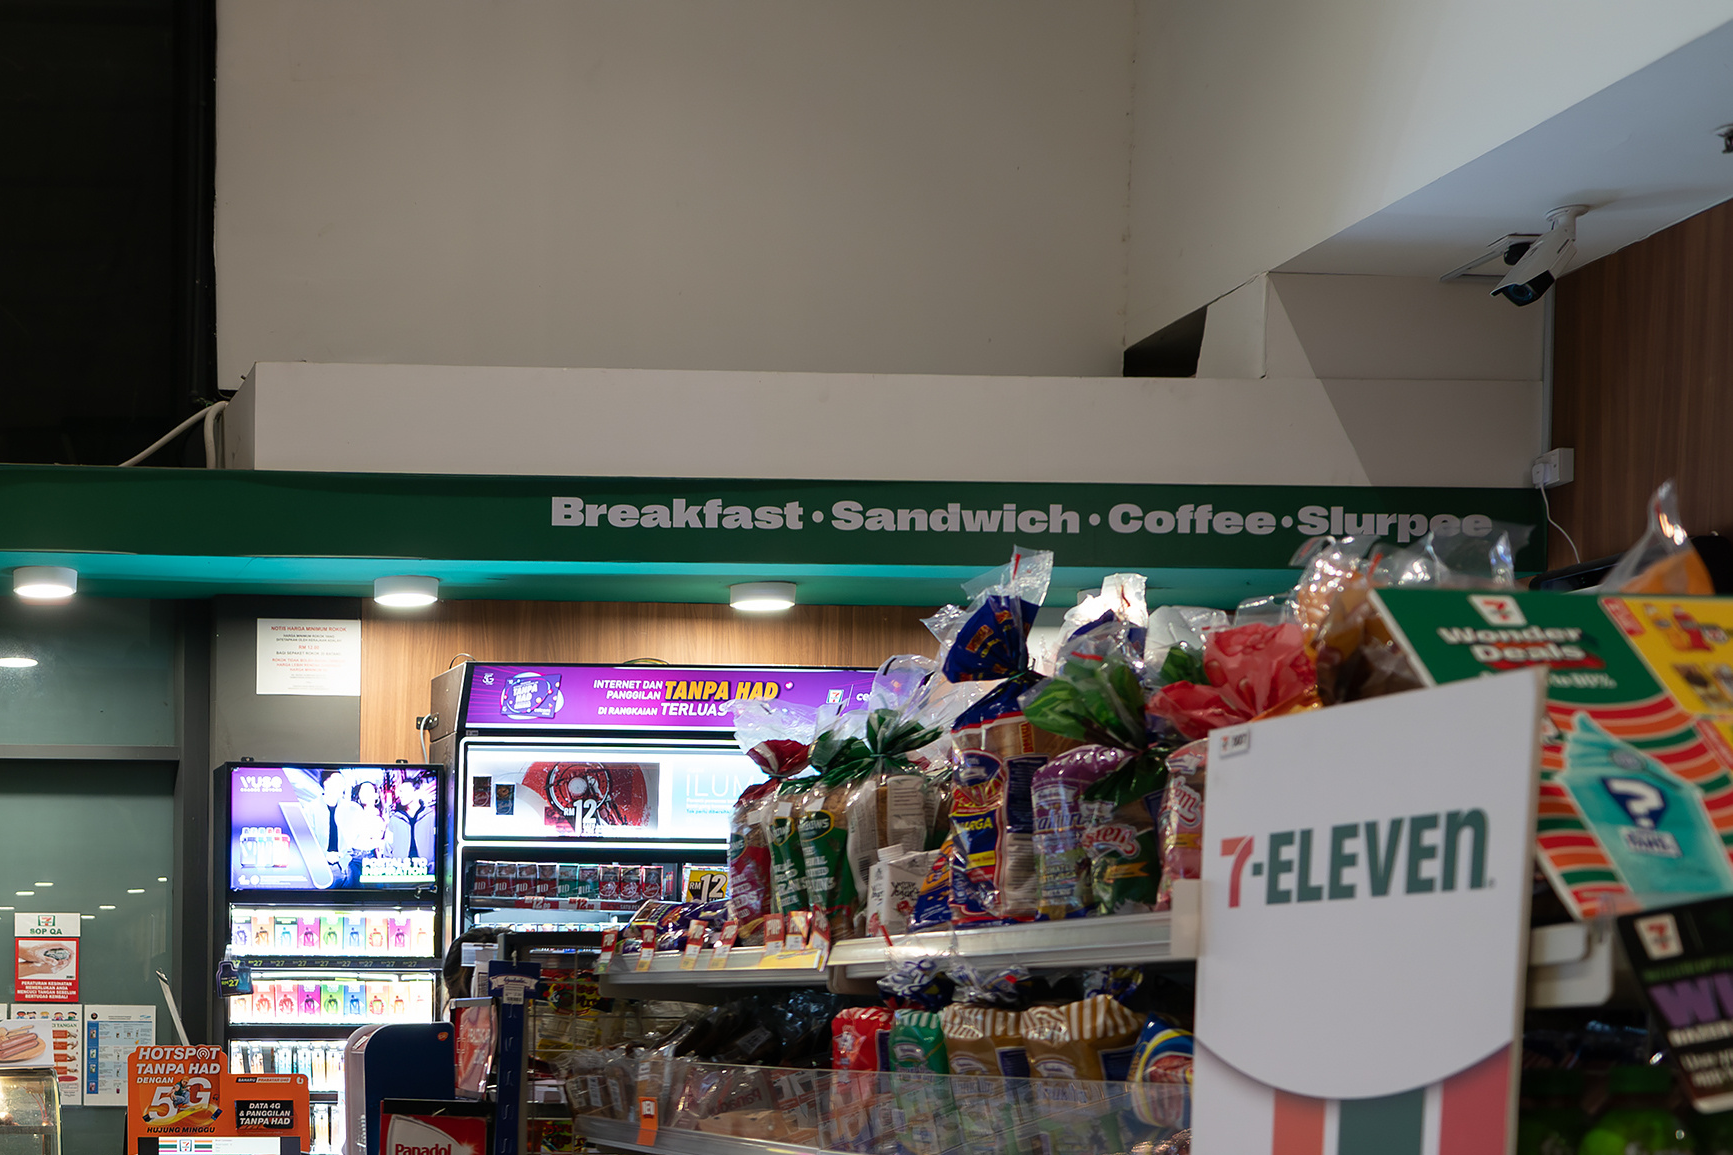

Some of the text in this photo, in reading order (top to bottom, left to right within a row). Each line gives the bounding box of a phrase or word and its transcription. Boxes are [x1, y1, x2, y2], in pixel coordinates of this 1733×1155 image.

[551, 496, 1493, 543] Breakfast Sandwich Coffee Slurpee
[1436, 626, 1583, 645] Wonder
[1469, 643, 1588, 663] Deals
[593, 679, 664, 691] INTERNET DAN
[664, 680, 779, 701] TANPA HAD
[606, 690, 662, 700] PANGGILAN
[598, 705, 658, 716] DI RANGKAIAN
[660, 702, 729, 717] TERLUAS
[575, 798, 597, 832] 12
[689, 874, 728, 899] RM 12
[49, 928, 63, 936] QA
[136, 1063, 221, 1075] TANPA HAD
[149, 1077, 212, 1120] 5G
[239, 1117, 291, 1125] TANPA HAD
